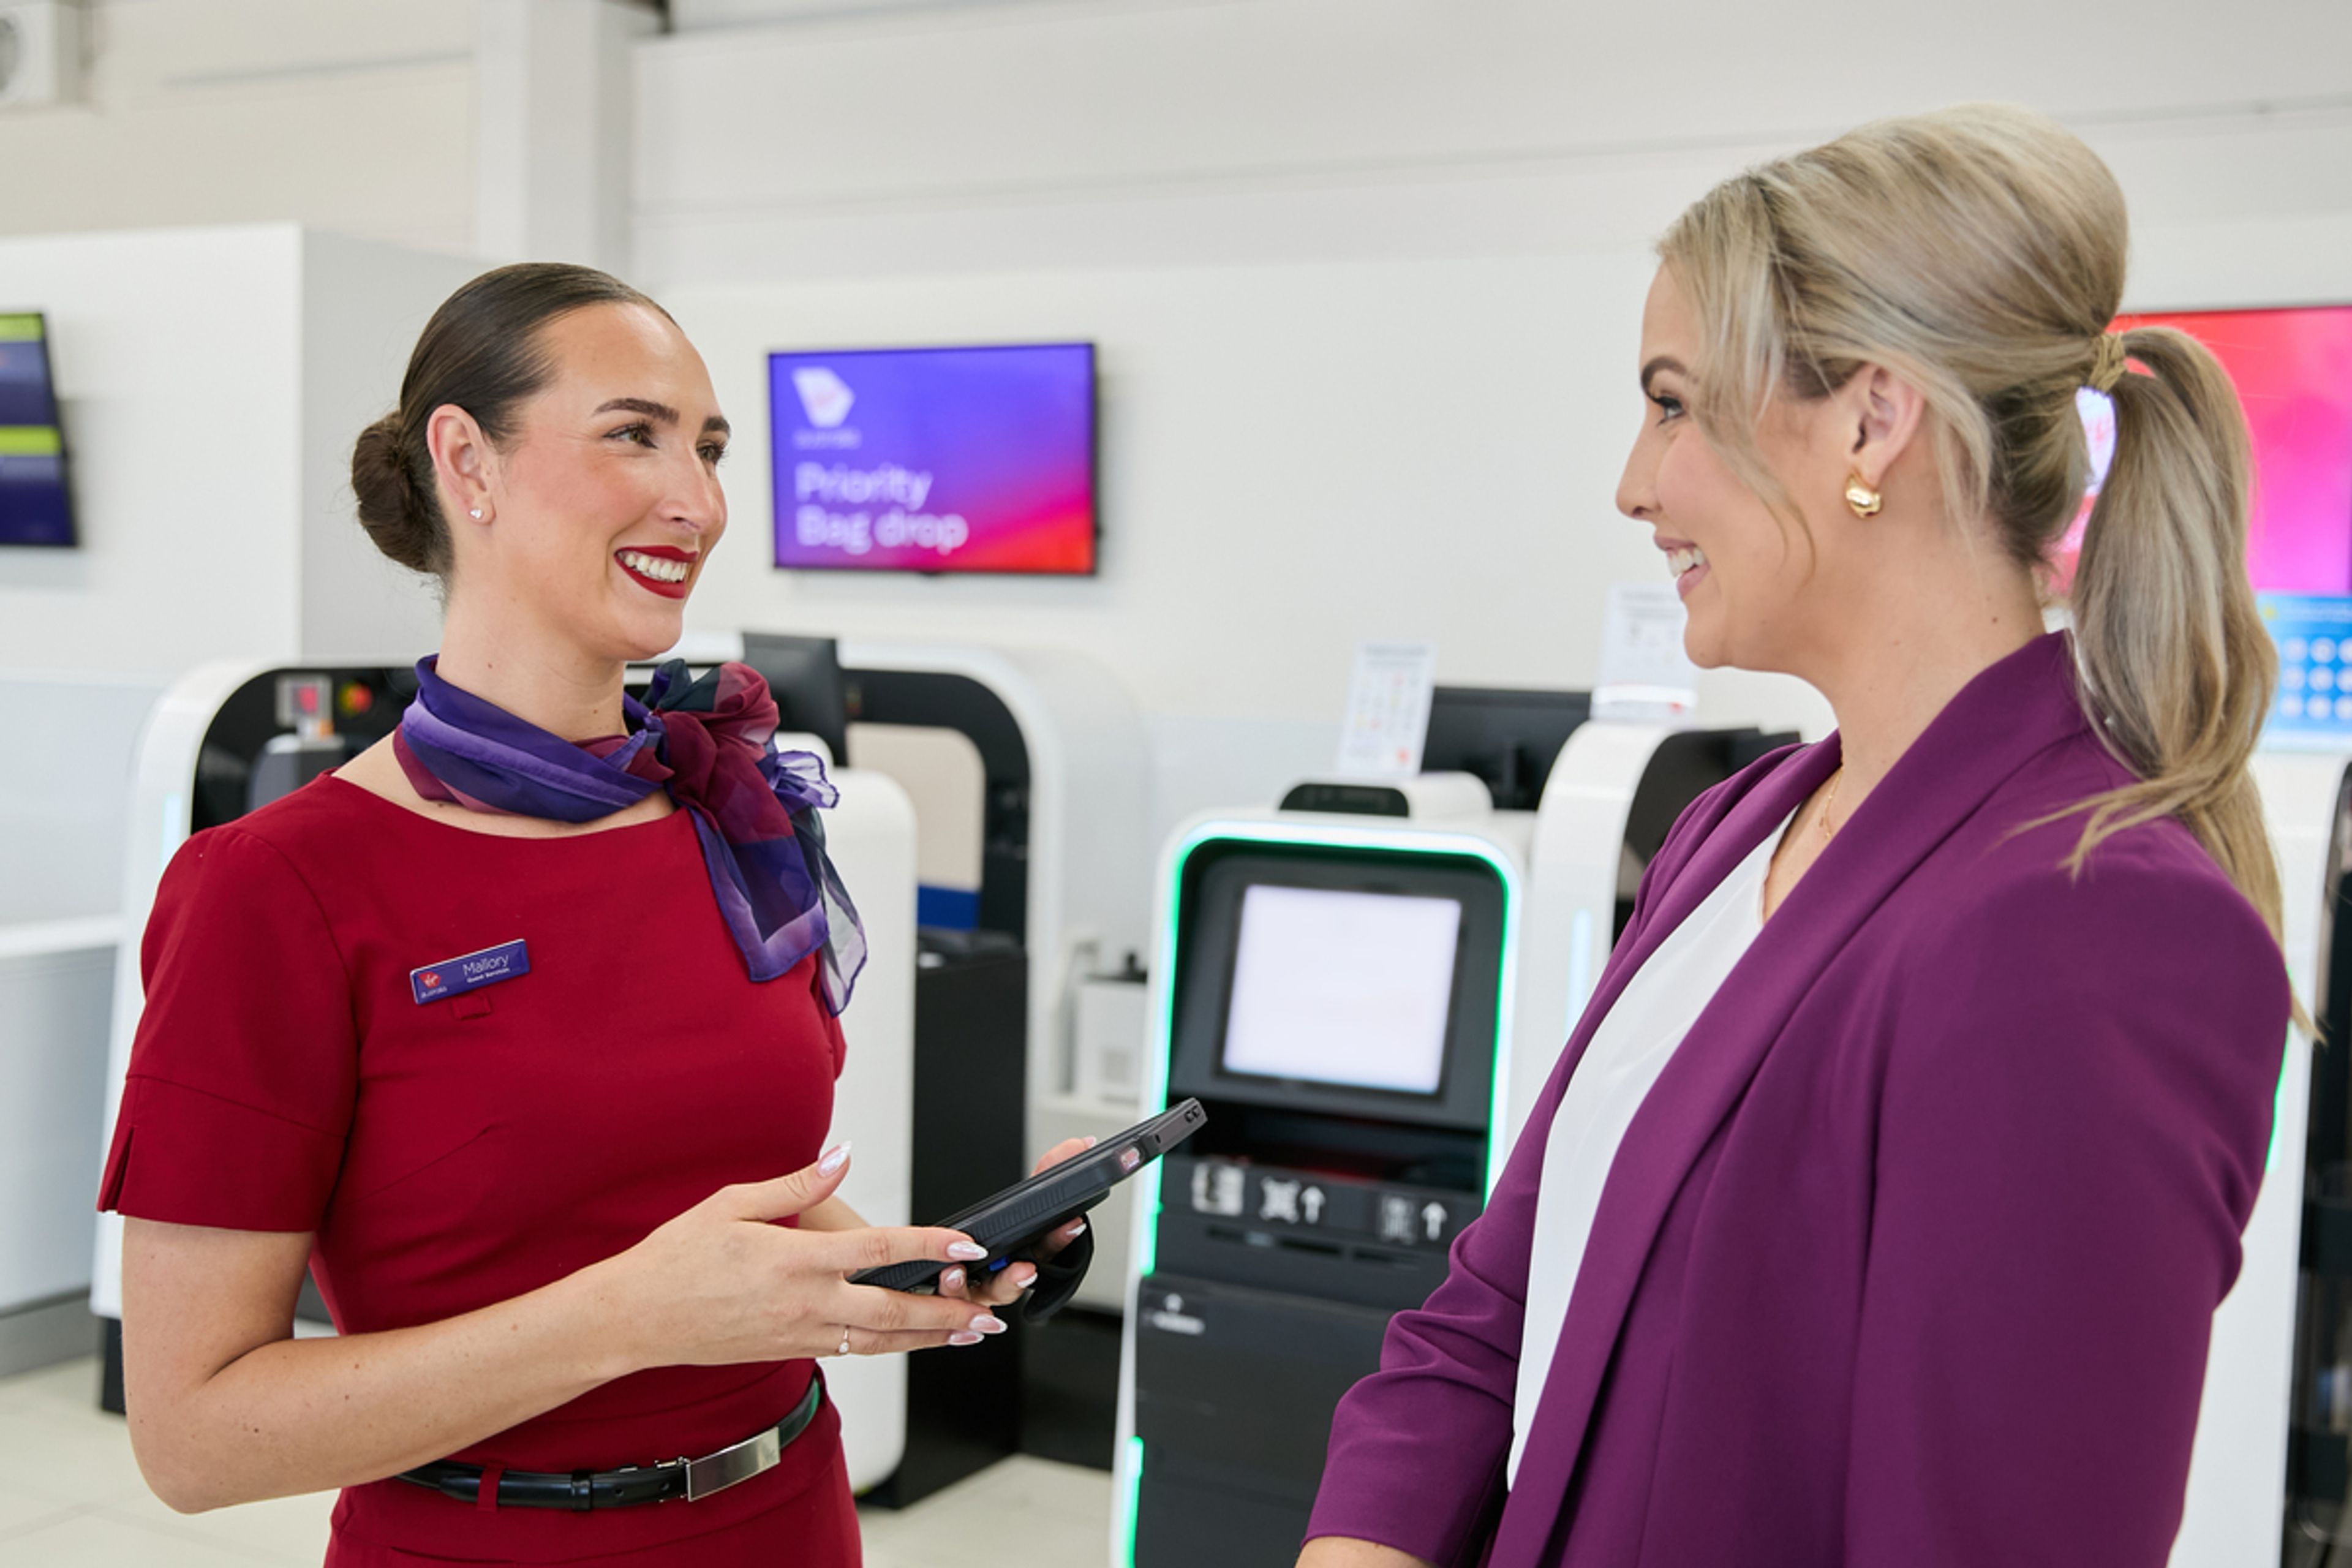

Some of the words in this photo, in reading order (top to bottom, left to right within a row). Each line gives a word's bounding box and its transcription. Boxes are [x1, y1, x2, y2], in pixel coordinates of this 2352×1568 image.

[795, 462, 932, 511] Priority
[796, 505, 872, 554] Bag
[874, 507, 968, 555] drop
[462, 955, 509, 975] Mallory
